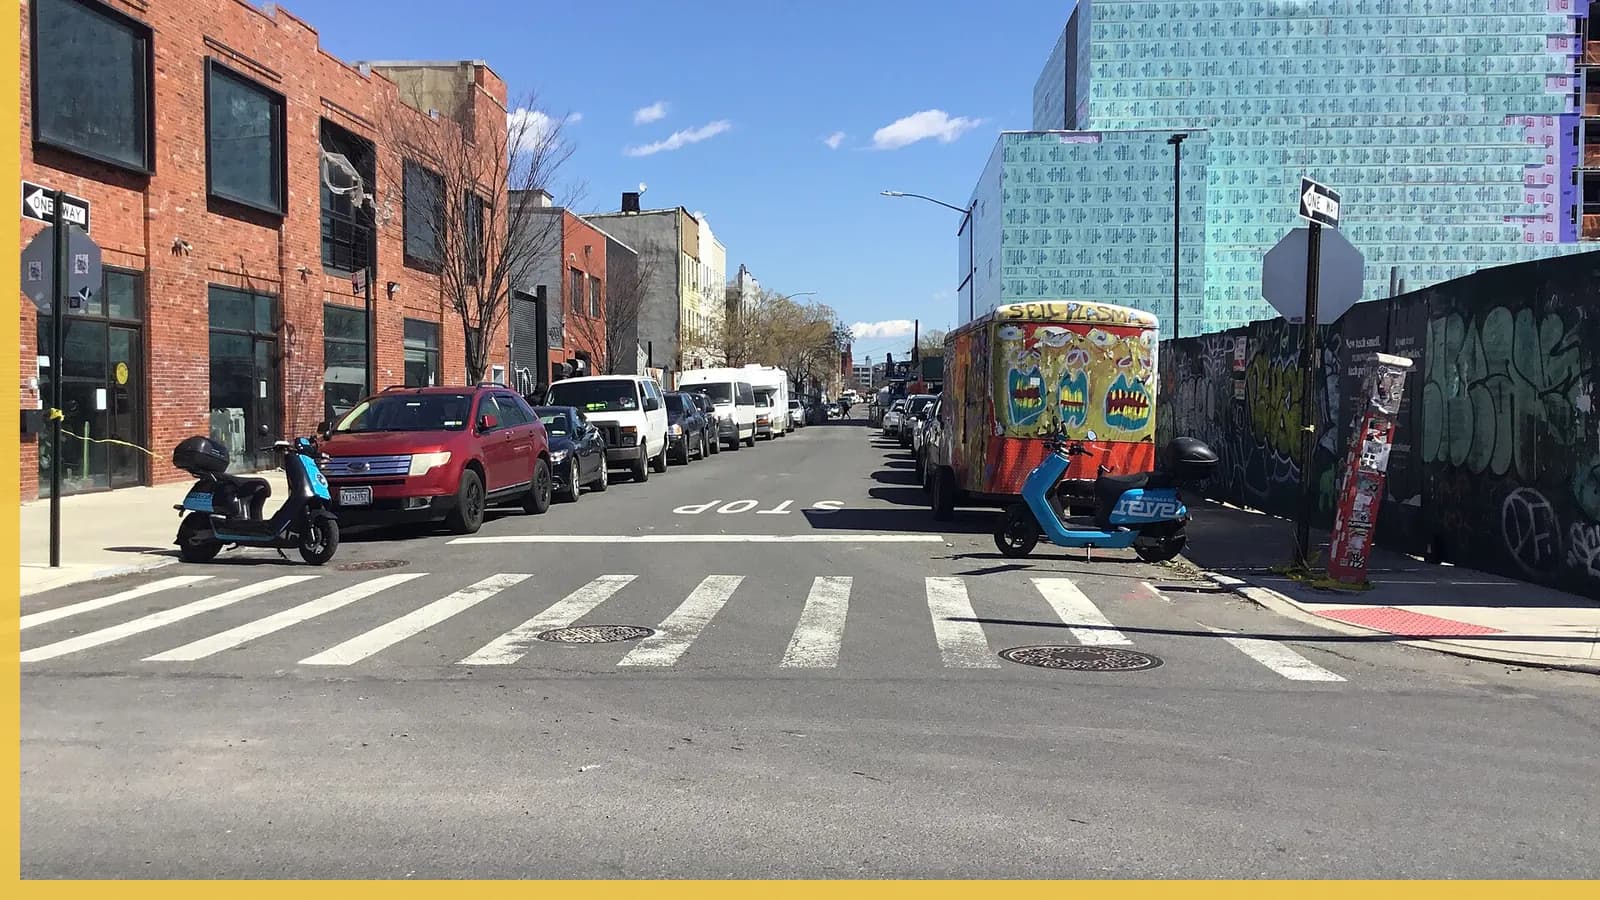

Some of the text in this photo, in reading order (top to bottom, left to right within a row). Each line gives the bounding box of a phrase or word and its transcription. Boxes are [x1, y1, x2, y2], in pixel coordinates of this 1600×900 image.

[33, 196, 82, 221] ONE WAY
[1307, 192, 1321, 210] ONE
[1009, 302, 1144, 323] SELL PLASMA
[672, 499, 845, 514] STOP
